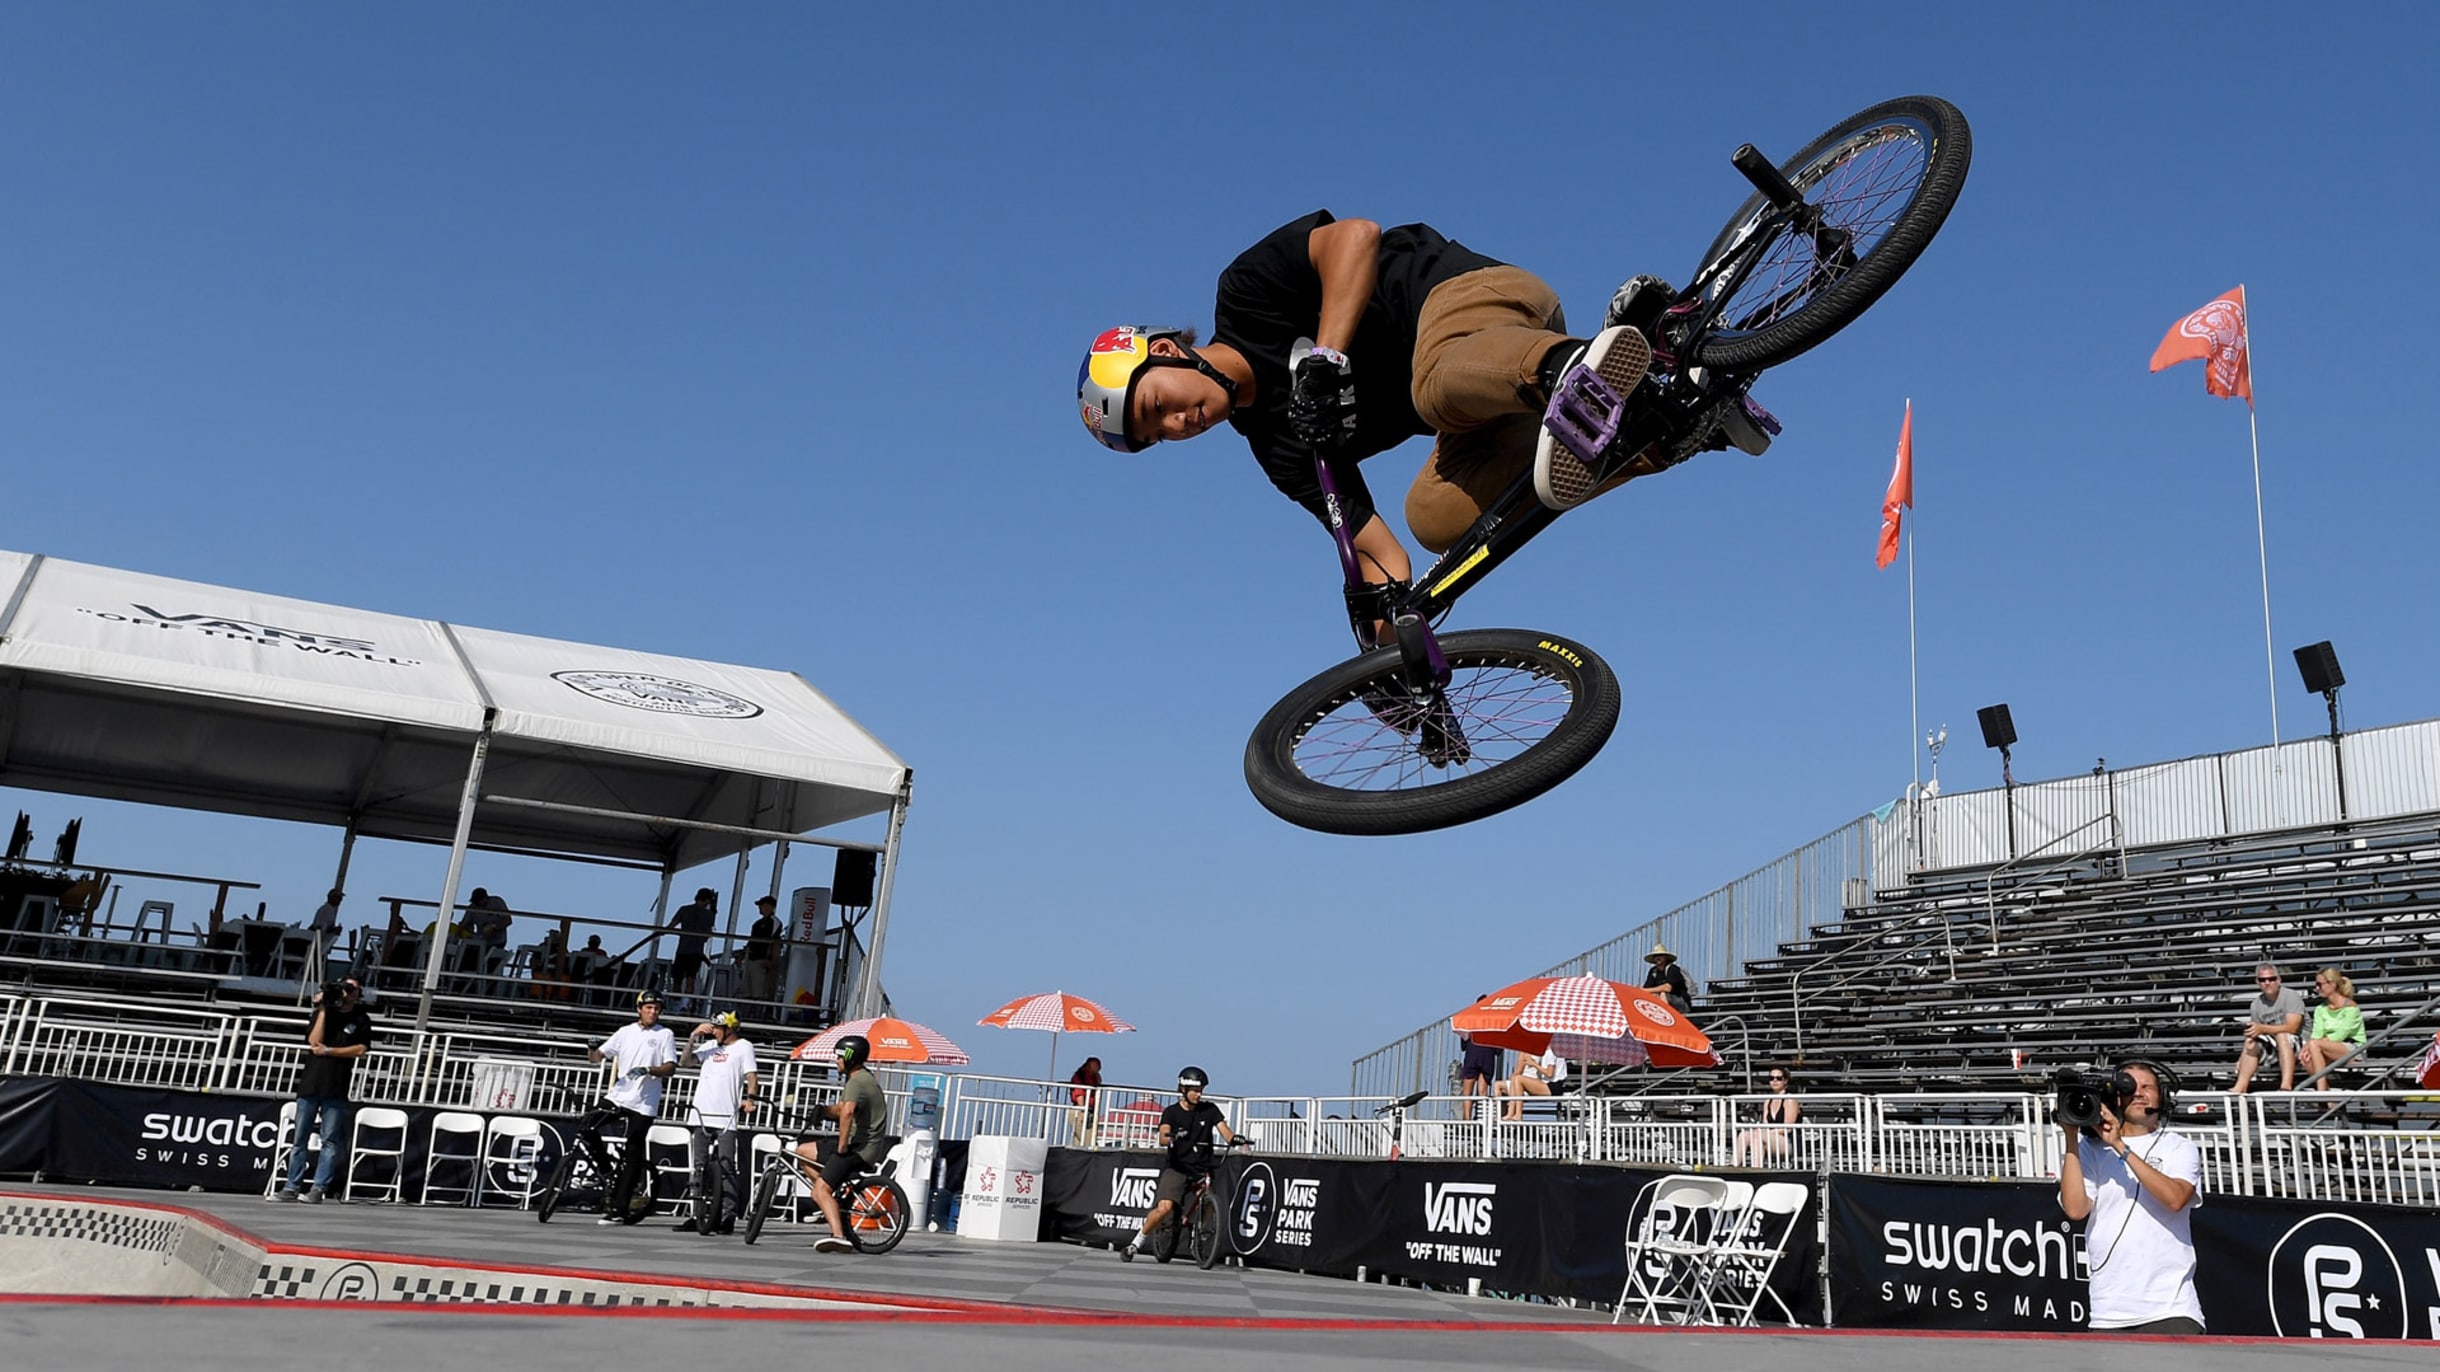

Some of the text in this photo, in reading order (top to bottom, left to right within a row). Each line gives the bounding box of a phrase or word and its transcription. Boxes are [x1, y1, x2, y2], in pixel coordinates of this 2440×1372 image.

[131, 603, 375, 652] VANS
[197, 627, 281, 647] THE
[1538, 640, 1583, 668] MAXXIS
[136, 1147, 230, 1168] SWISS
[1110, 1167, 1161, 1209] VANS
[1284, 1178, 1320, 1208] VANS
[1115, 1215, 1133, 1230] THE
[1277, 1208, 1315, 1230] PARK
[1425, 1182, 1497, 1236] VANS
[1275, 1229, 1312, 1247] SERIES
[1883, 1217, 2068, 1280] swatch
[1434, 1243, 1461, 1263] THE
[1881, 1280, 2085, 1323] SWISS MAD
